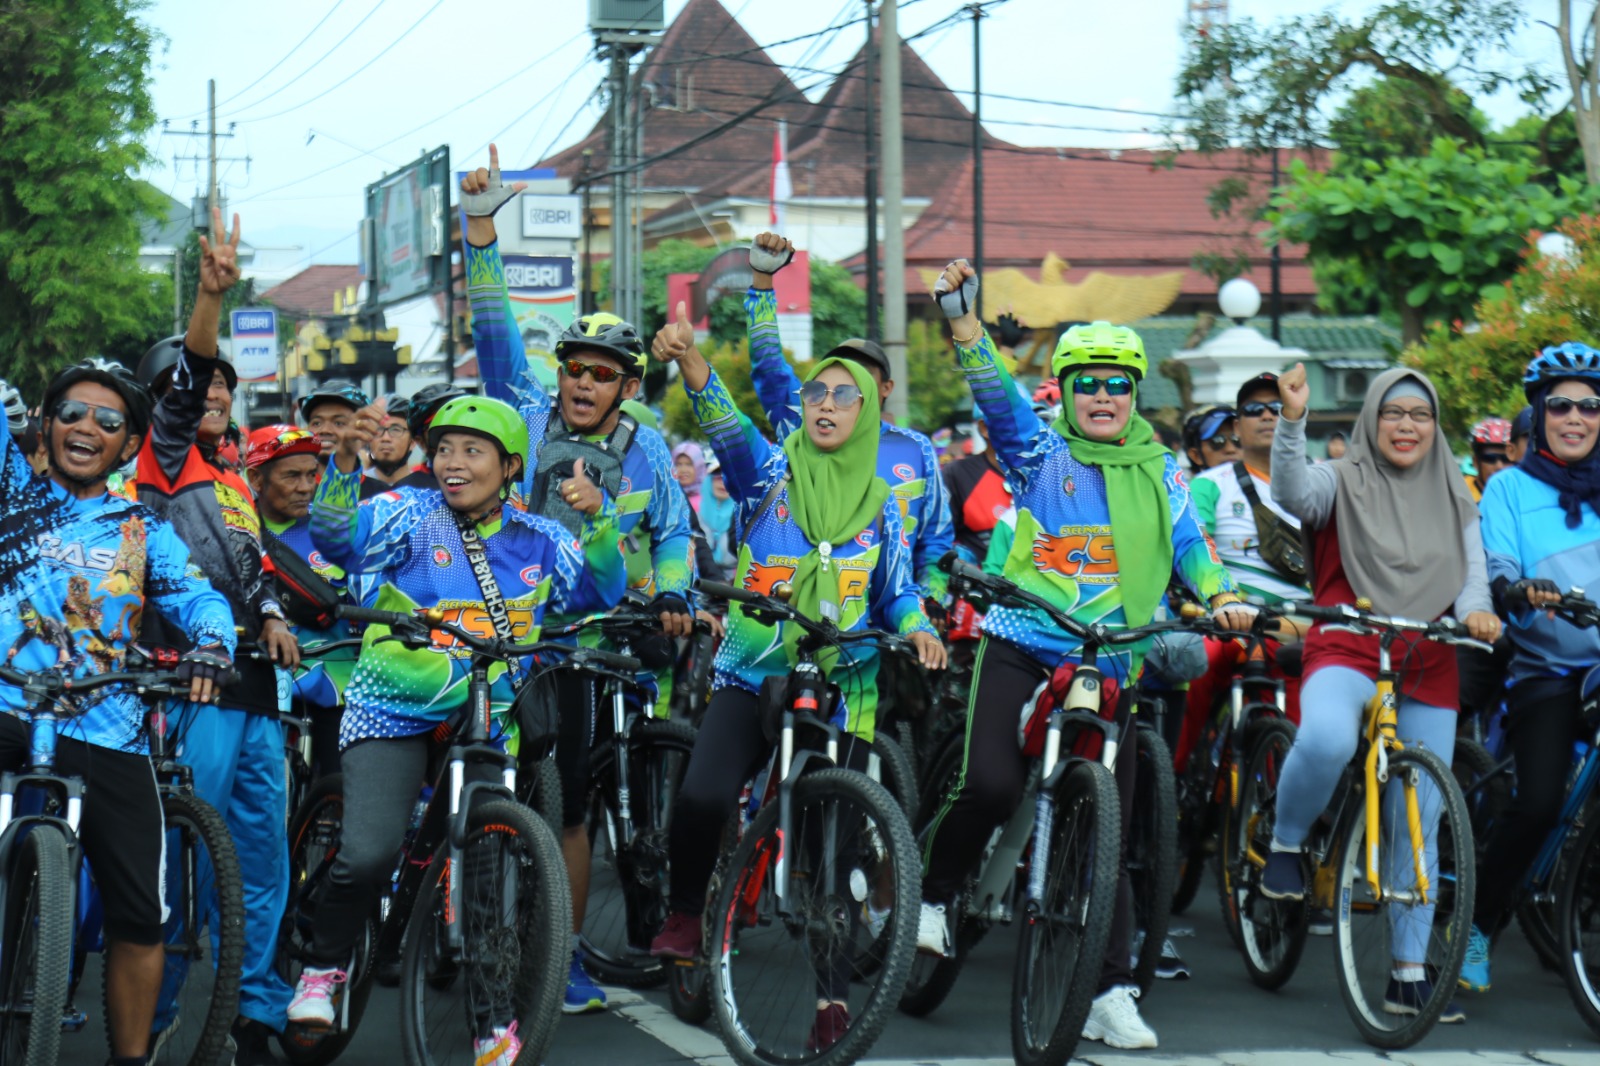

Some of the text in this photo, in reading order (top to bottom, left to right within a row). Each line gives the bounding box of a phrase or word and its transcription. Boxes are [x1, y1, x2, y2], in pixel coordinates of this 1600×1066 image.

[545, 209, 571, 224] BRI
[524, 265, 562, 287] BRI
[249, 317, 268, 329] BRI
[241, 346, 269, 356] ATM
[38, 533, 117, 572] GAS
